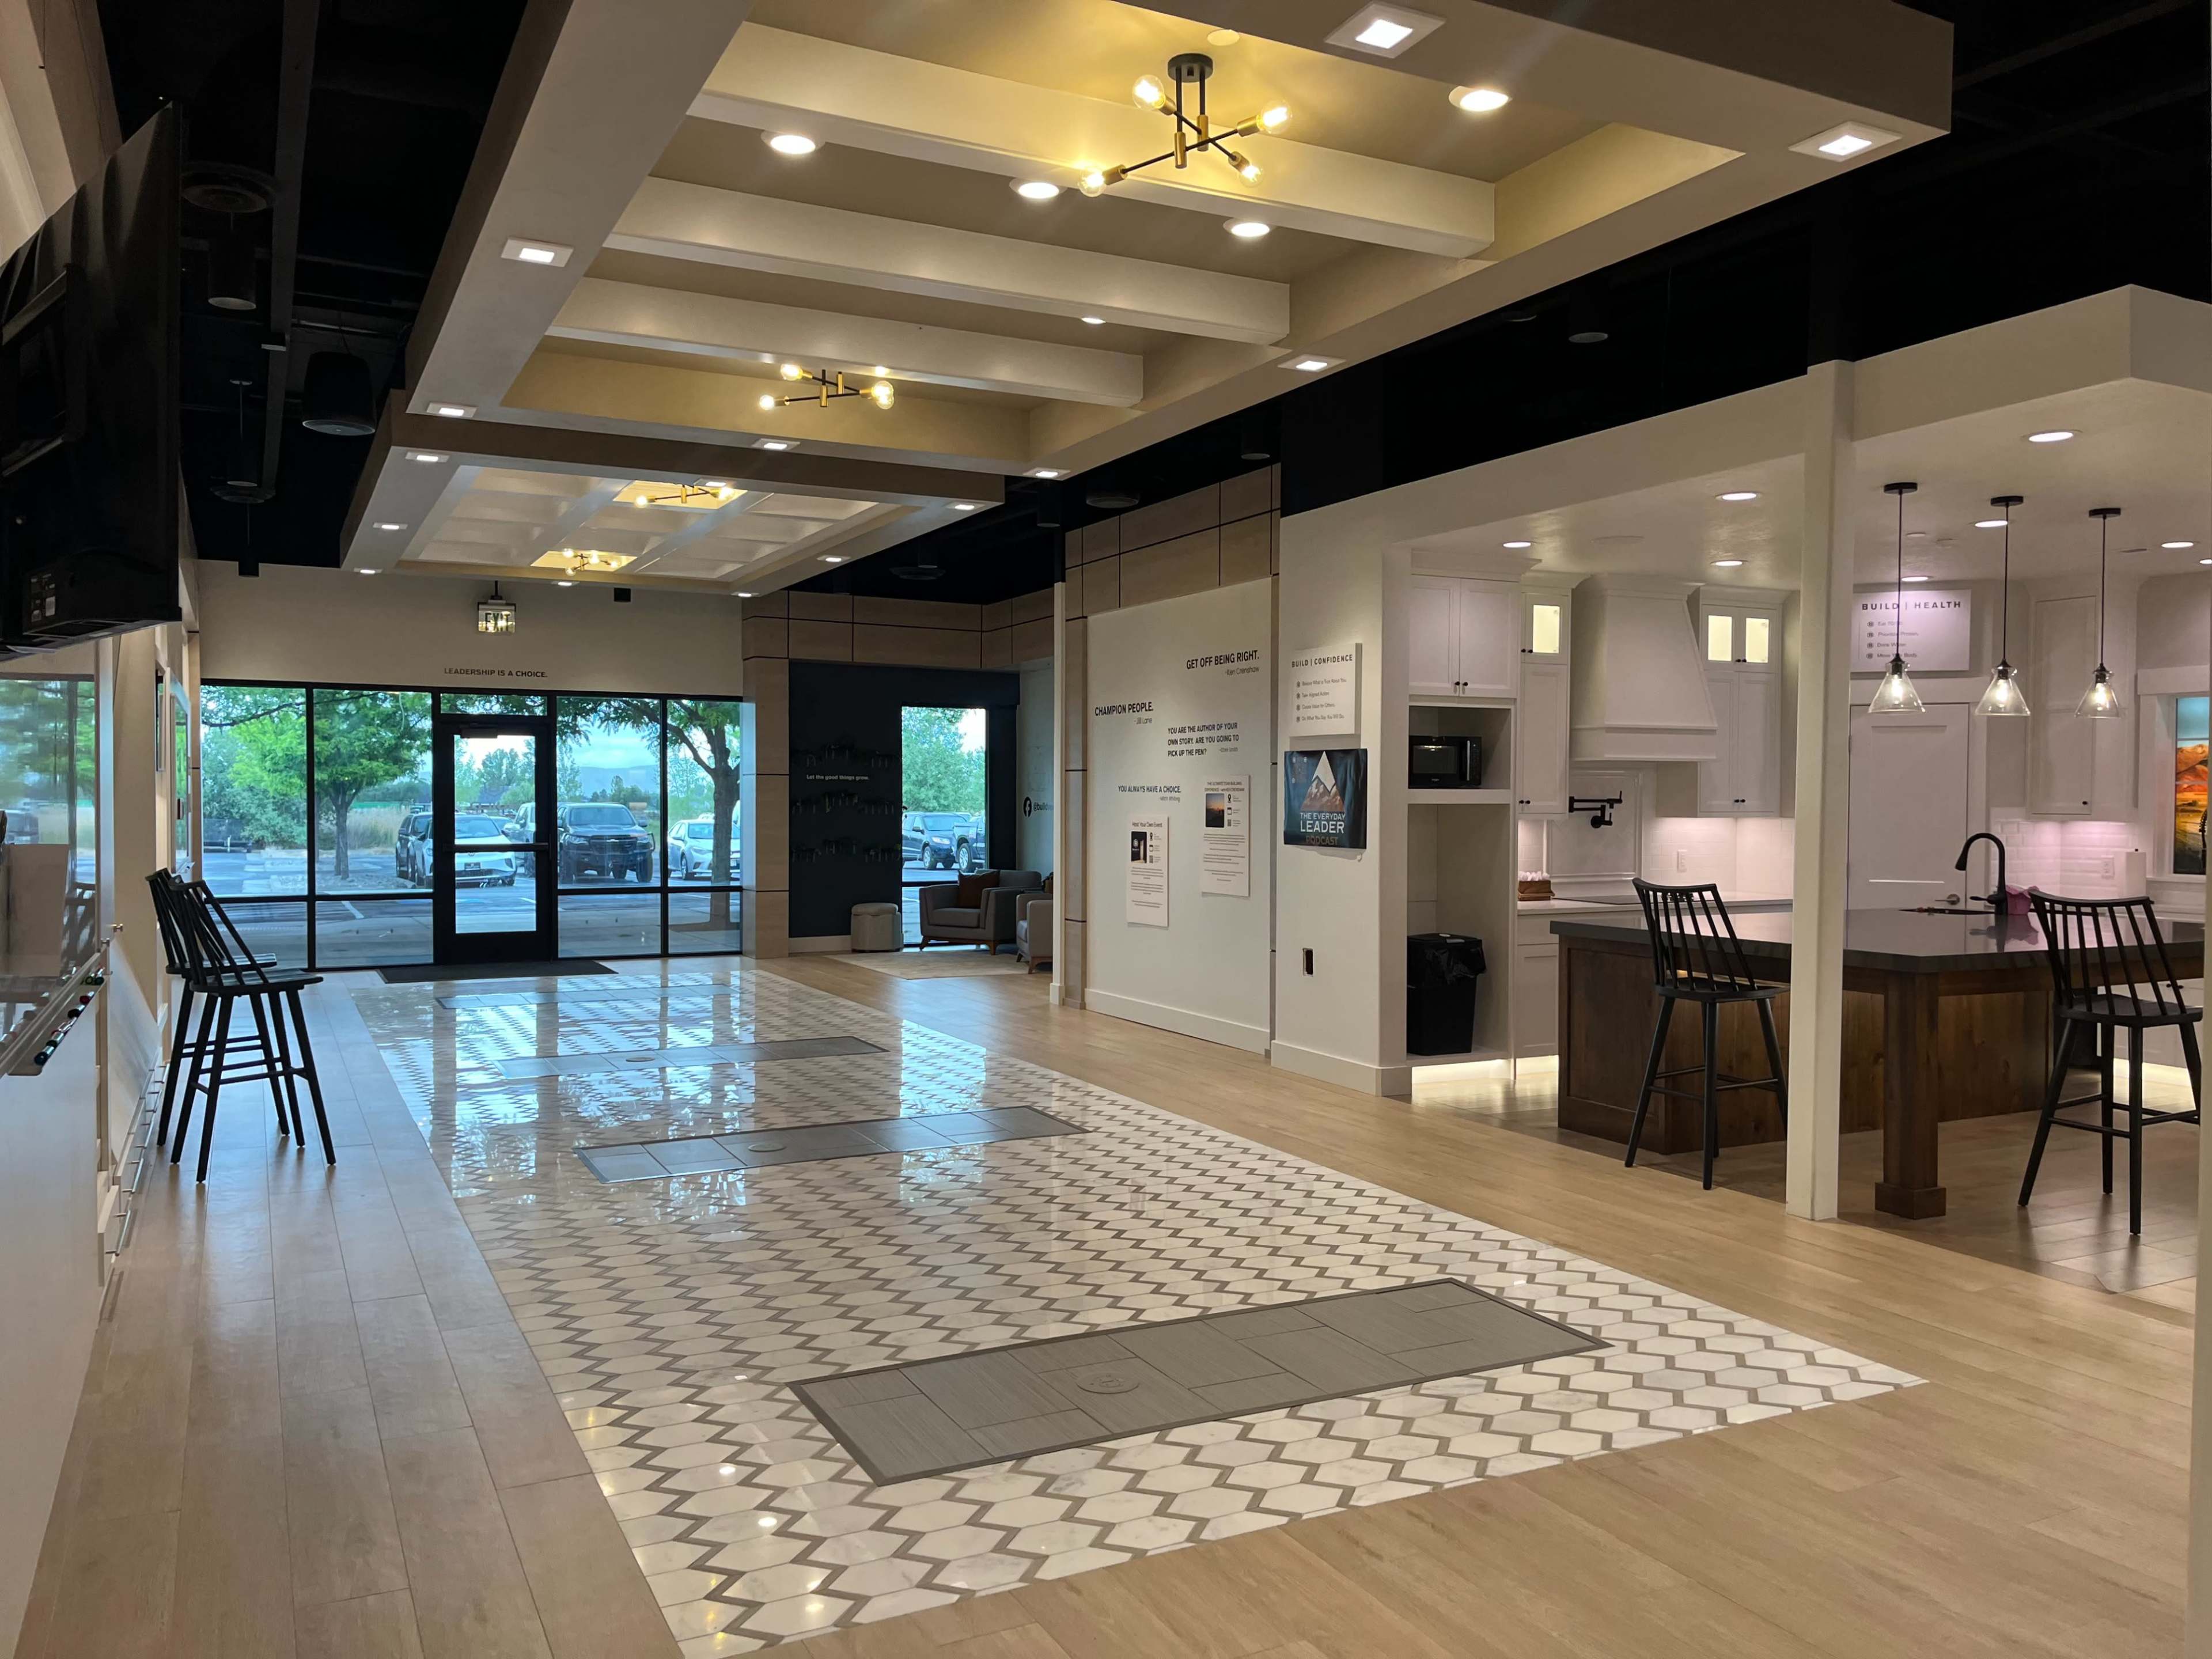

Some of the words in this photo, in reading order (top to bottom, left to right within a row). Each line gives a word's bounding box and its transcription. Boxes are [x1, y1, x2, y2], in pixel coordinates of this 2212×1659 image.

[485, 612, 510, 631] EXIT
[1187, 658, 1199, 669] GET
[1200, 657, 1213, 668] OFF
[1214, 653, 1235, 665] BEING
[1237, 650, 1259, 662] RIGHT.
[1291, 659, 1309, 668] BUILD
[1314, 654, 1353, 665] CONFIDENCE
[444, 668, 495, 676] LEADERSHIP
[516, 670, 548, 678] CHOICE.
[1094, 704, 1127, 716] CHAMPION
[1128, 702, 1154, 713] PEOPLE.
[1118, 785, 1127, 793] YOU
[1300, 820, 1344, 834] LEADER
[1306, 835, 1338, 846] PODCAST
